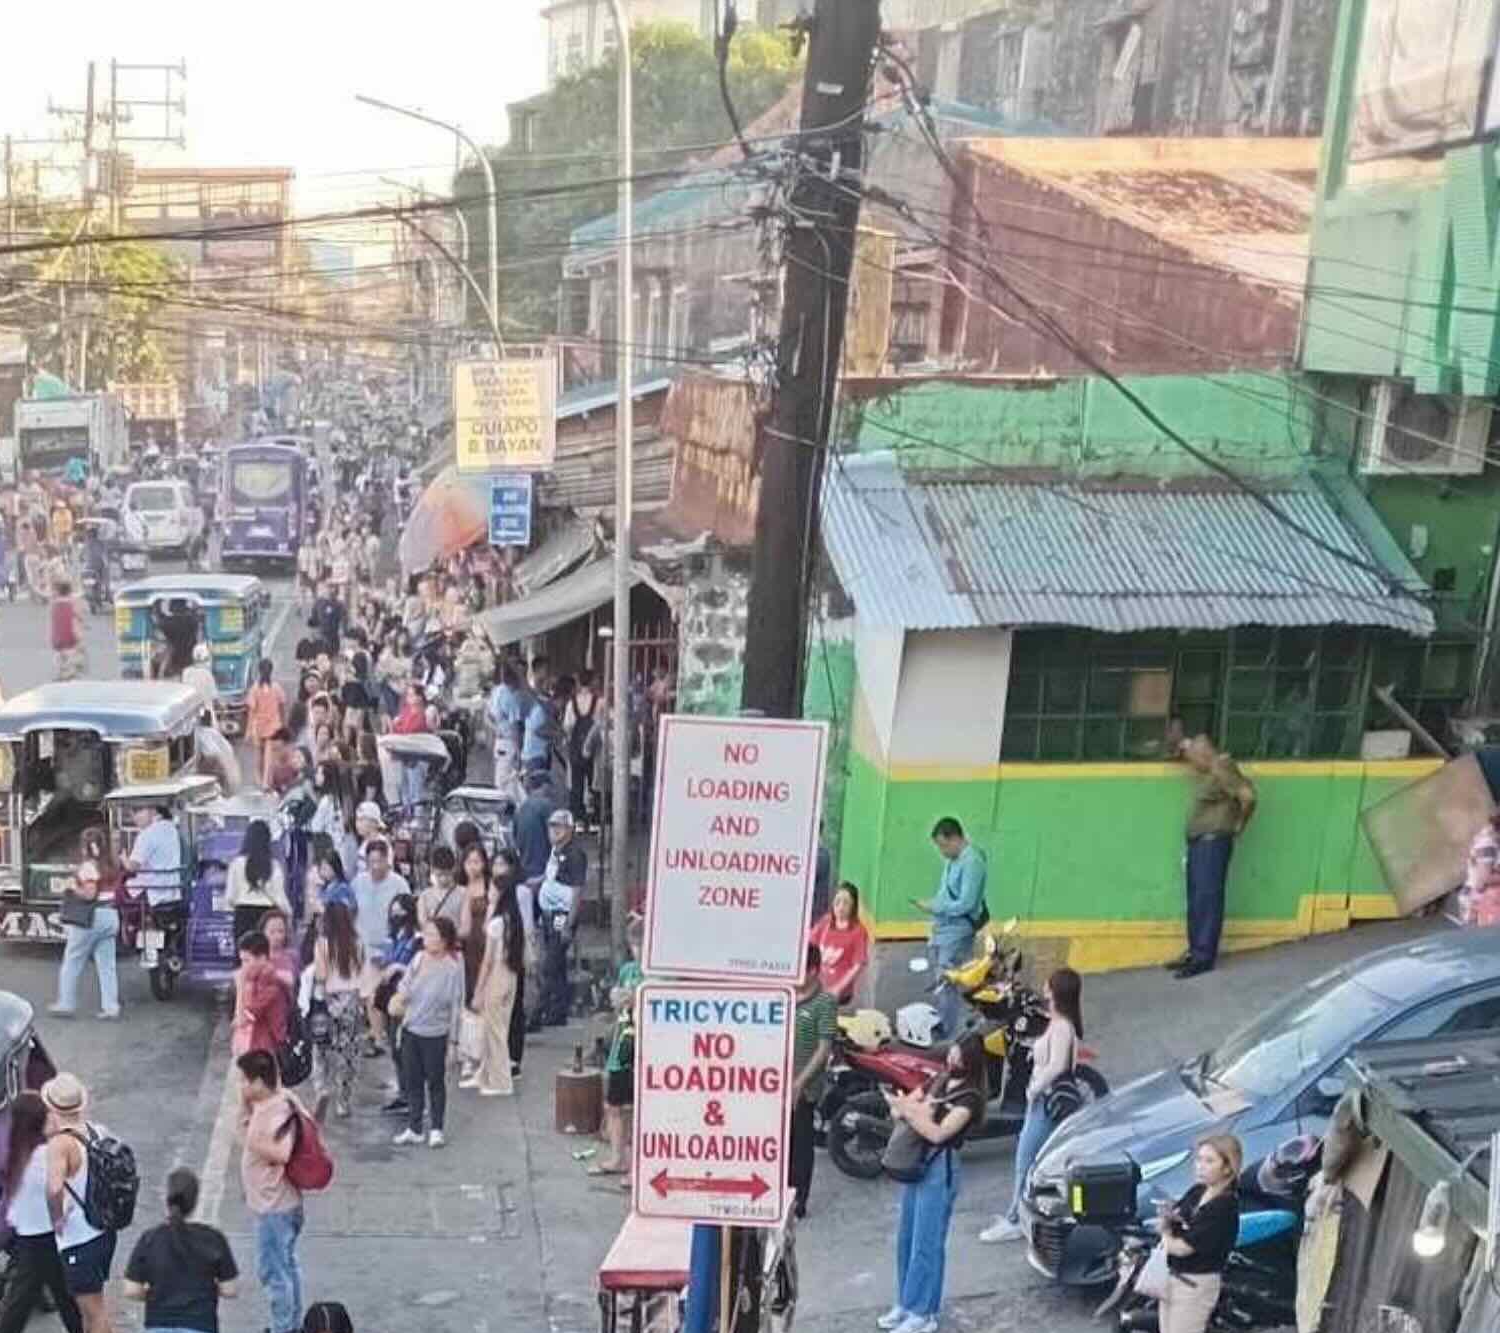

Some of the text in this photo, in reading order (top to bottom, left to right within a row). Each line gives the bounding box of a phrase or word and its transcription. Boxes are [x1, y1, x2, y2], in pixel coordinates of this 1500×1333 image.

[723, 743, 759, 764] NO
[687, 777, 790, 802] LOADING
[710, 815, 760, 837] AND
[665, 845, 800, 876] UNLOADING
[699, 886, 761, 909] ZONE
[650, 999, 784, 1025] TRICYCLE
[693, 1033, 736, 1059] NO
[646, 1065, 781, 1093] LOADING
[703, 1101, 725, 1127] &
[643, 1134, 779, 1162] UNLOADING
